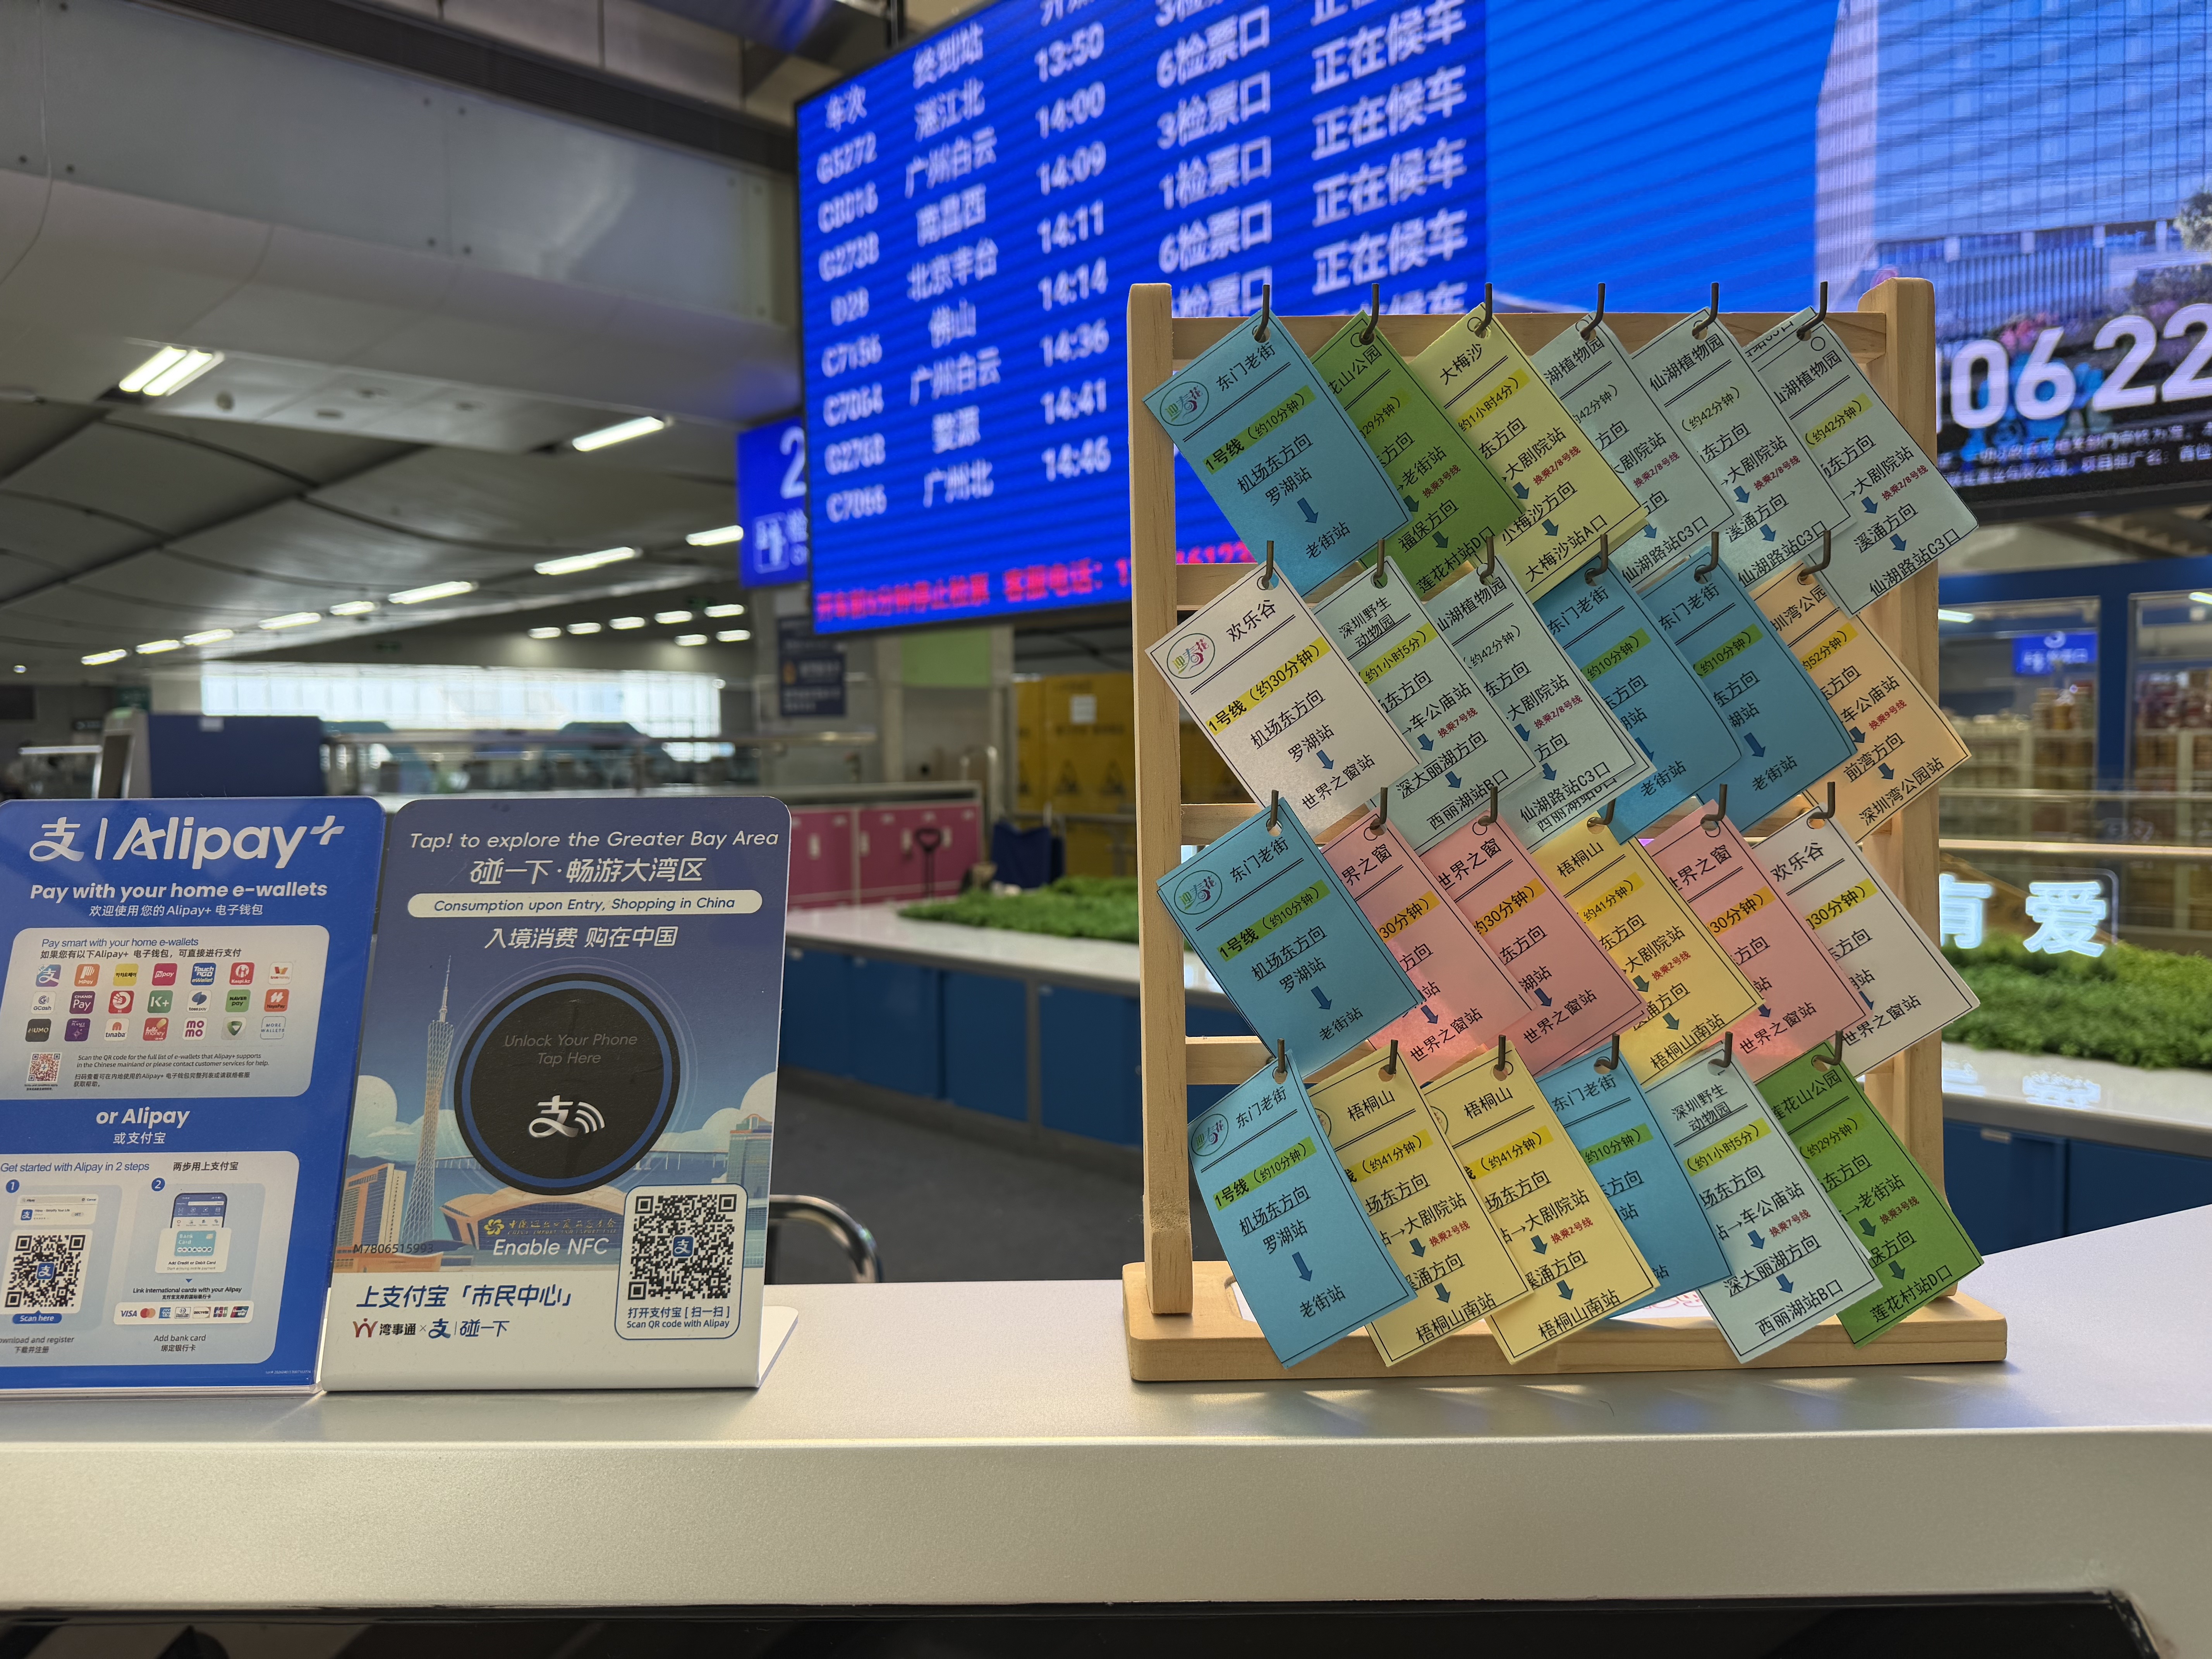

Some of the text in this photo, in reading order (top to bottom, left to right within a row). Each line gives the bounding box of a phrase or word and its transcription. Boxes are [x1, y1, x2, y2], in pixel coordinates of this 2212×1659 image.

[1036, 22, 1104, 82] 13:50
[1036, 82, 1105, 138] 14:00
[1157, 5, 1270, 88] 6检票口
[1311, 0, 1467, 94] 正在候车
[1037, 141, 1106, 195] 14:09
[1157, 70, 1270, 149] 3检票口
[1311, 65, 1467, 160] 正在候车
[1037, 199, 1103, 252] 14:11
[1160, 136, 1271, 210] 1检票口
[1312, 137, 1467, 227] 正在候车
[1038, 257, 1108, 310] 14:14
[1159, 200, 1272, 273] 6检票口
[1312, 208, 1468, 295] 正在候车
[1040, 319, 1109, 367] 14:36
[1440, 342, 1484, 385] 大梅沙
[1649, 333, 1724, 391] 仙湖植物园
[1217, 342, 1276, 391] 东门老街
[1041, 378, 1107, 424] 14:41
[1041, 436, 1111, 481] 14:46
[1237, 434, 1313, 493] 机场东方向
[1401, 447, 1447, 486] 老街站
[1533, 446, 1581, 486] 换乘2/8号线
[1633, 452, 1680, 488] 换乘2/8号线
[1265, 467, 1312, 506] 罗湖站
[1423, 465, 1461, 498] 换乘3号线
[1881, 465, 1929, 501] 换乘2/8号线
[1398, 500, 1458, 552] 福保方向
[1502, 481, 1577, 544] 小梅沙方向
[1725, 494, 1789, 543] 溪涌方向
[1854, 504, 1918, 553] 溪涌方向
[1305, 522, 1351, 558] 老街站
[1526, 515, 1607, 582] 大梅沙站A口
[1622, 516, 1708, 583] 仙湖路站C3口
[1870, 529, 1960, 596] 仙湖路站C3口
[1226, 599, 1276, 642] 欢乐谷
[1338, 597, 1391, 639] 深圳野生
[1659, 583, 1720, 631] 东门老街
[1355, 614, 1396, 647] 动物园
[1208, 645, 1321, 732] 1号线（约30分钟）
[1250, 689, 1325, 749] 机场东方向
[1437, 707, 1479, 738] 换乘7号线
[1869, 699, 1907, 730] 换乘9号线
[1288, 725, 1334, 762] 罗湖站
[1396, 731, 1489, 798] 深大丽湖方向
[1844, 732, 1905, 782] 前湾方向
[1302, 754, 1375, 810] 世界之窗站
[1520, 761, 1611, 823] 仙湖路站C3口
[1752, 755, 1798, 792] 老街站
[1860, 757, 1944, 826] 深圳湾公园站
[410, 830, 779, 852] Tap! to explore the Greater Bay Area
[1230, 836, 1289, 883] 东门老街
[1557, 841, 1604, 878] 梧桐山
[1771, 842, 1824, 882] 欢乐谷
[30, 882, 327, 903] Pay with your home e-wallets
[434, 896, 735, 913] Consumption upon Entry, Shopping in China
[485, 926, 678, 949] 入境消费 购在中国
[1252, 925, 1327, 981] 机场东方向
[1279, 957, 1326, 993] 罗湖站
[1651, 951, 1691, 981] 换乘2号线
[1524, 989, 1597, 1044] 世界之窗站
[1841, 994, 1921, 1046] 世界之窗站
[505, 1034, 637, 1047] Unlock Your Phone
[538, 1052, 601, 1066] Tap Here
[1650, 1013, 1726, 1070] 梧桐山南站
[96, 1106, 191, 1128] or Alipay
[1348, 1090, 1395, 1121] 梧桐山
[1464, 1087, 1513, 1119] 梧桐山
[1671, 1084, 1727, 1120] 深圳野生
[1689, 1101, 1730, 1131] 动物园
[113, 1132, 166, 1144] 或支付宝
[1686, 1123, 1759, 1172] （约1小时5分）
[1, 1163, 149, 1173] Get started with Alipay steps
[173, 1162, 239, 1171] 两步用上支付宝
[1550, 1217, 1593, 1245] 换乘2号线
[1769, 1209, 1811, 1237] 换乘7号线
[1879, 1196, 1919, 1224] 换乘3号线
[493, 1238, 609, 1255] Enable NFC
[1429, 1221, 1470, 1247] 换乘2号线
[1724, 1234, 1822, 1297] 深大丽湖方向
[356, 1285, 572, 1308] 上支付宝「市民中心」
[628, 1307, 682, 1318] 打开支付宝
[1539, 1289, 1621, 1340] 梧桐山南站
[1756, 1279, 1844, 1336] 西丽湖站B口
[1870, 1265, 1953, 1322] 莲花村站D口
[703, 1320, 729, 1328] Alipay
[1416, 1292, 1497, 1344] 梧桐山南站
